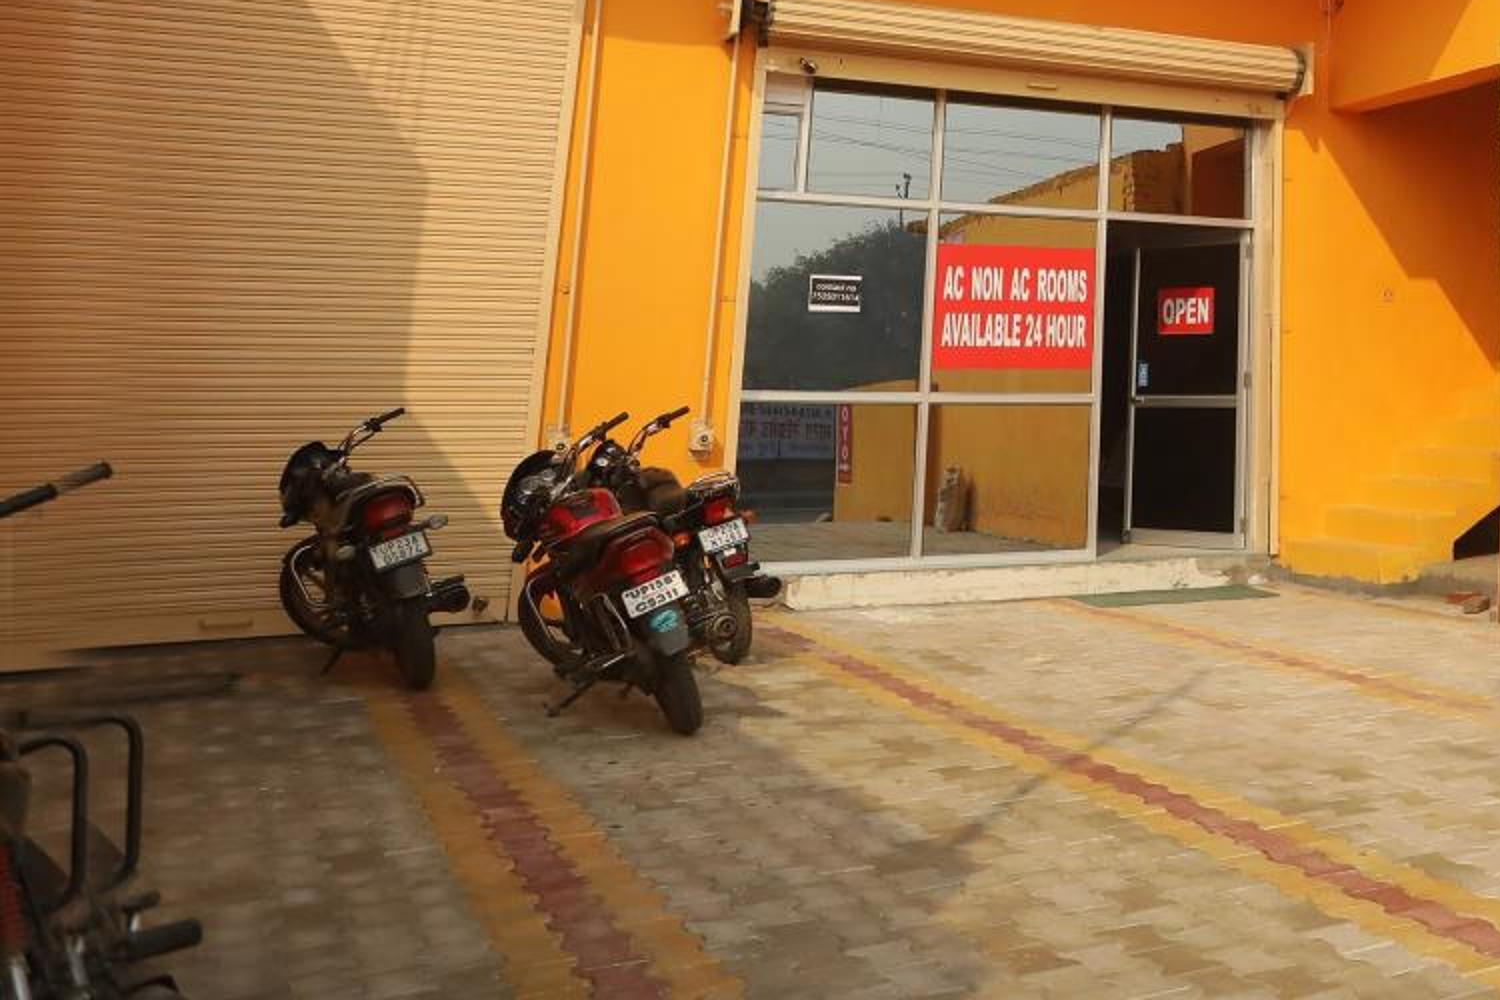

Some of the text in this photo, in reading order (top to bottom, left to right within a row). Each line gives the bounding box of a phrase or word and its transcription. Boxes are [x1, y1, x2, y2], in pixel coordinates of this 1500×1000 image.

[943, 265, 1087, 303] AC NON AC ROOMS
[1162, 297, 1210, 326] OPEN
[941, 313, 1087, 348] AVAILABLE 24 HOUR
